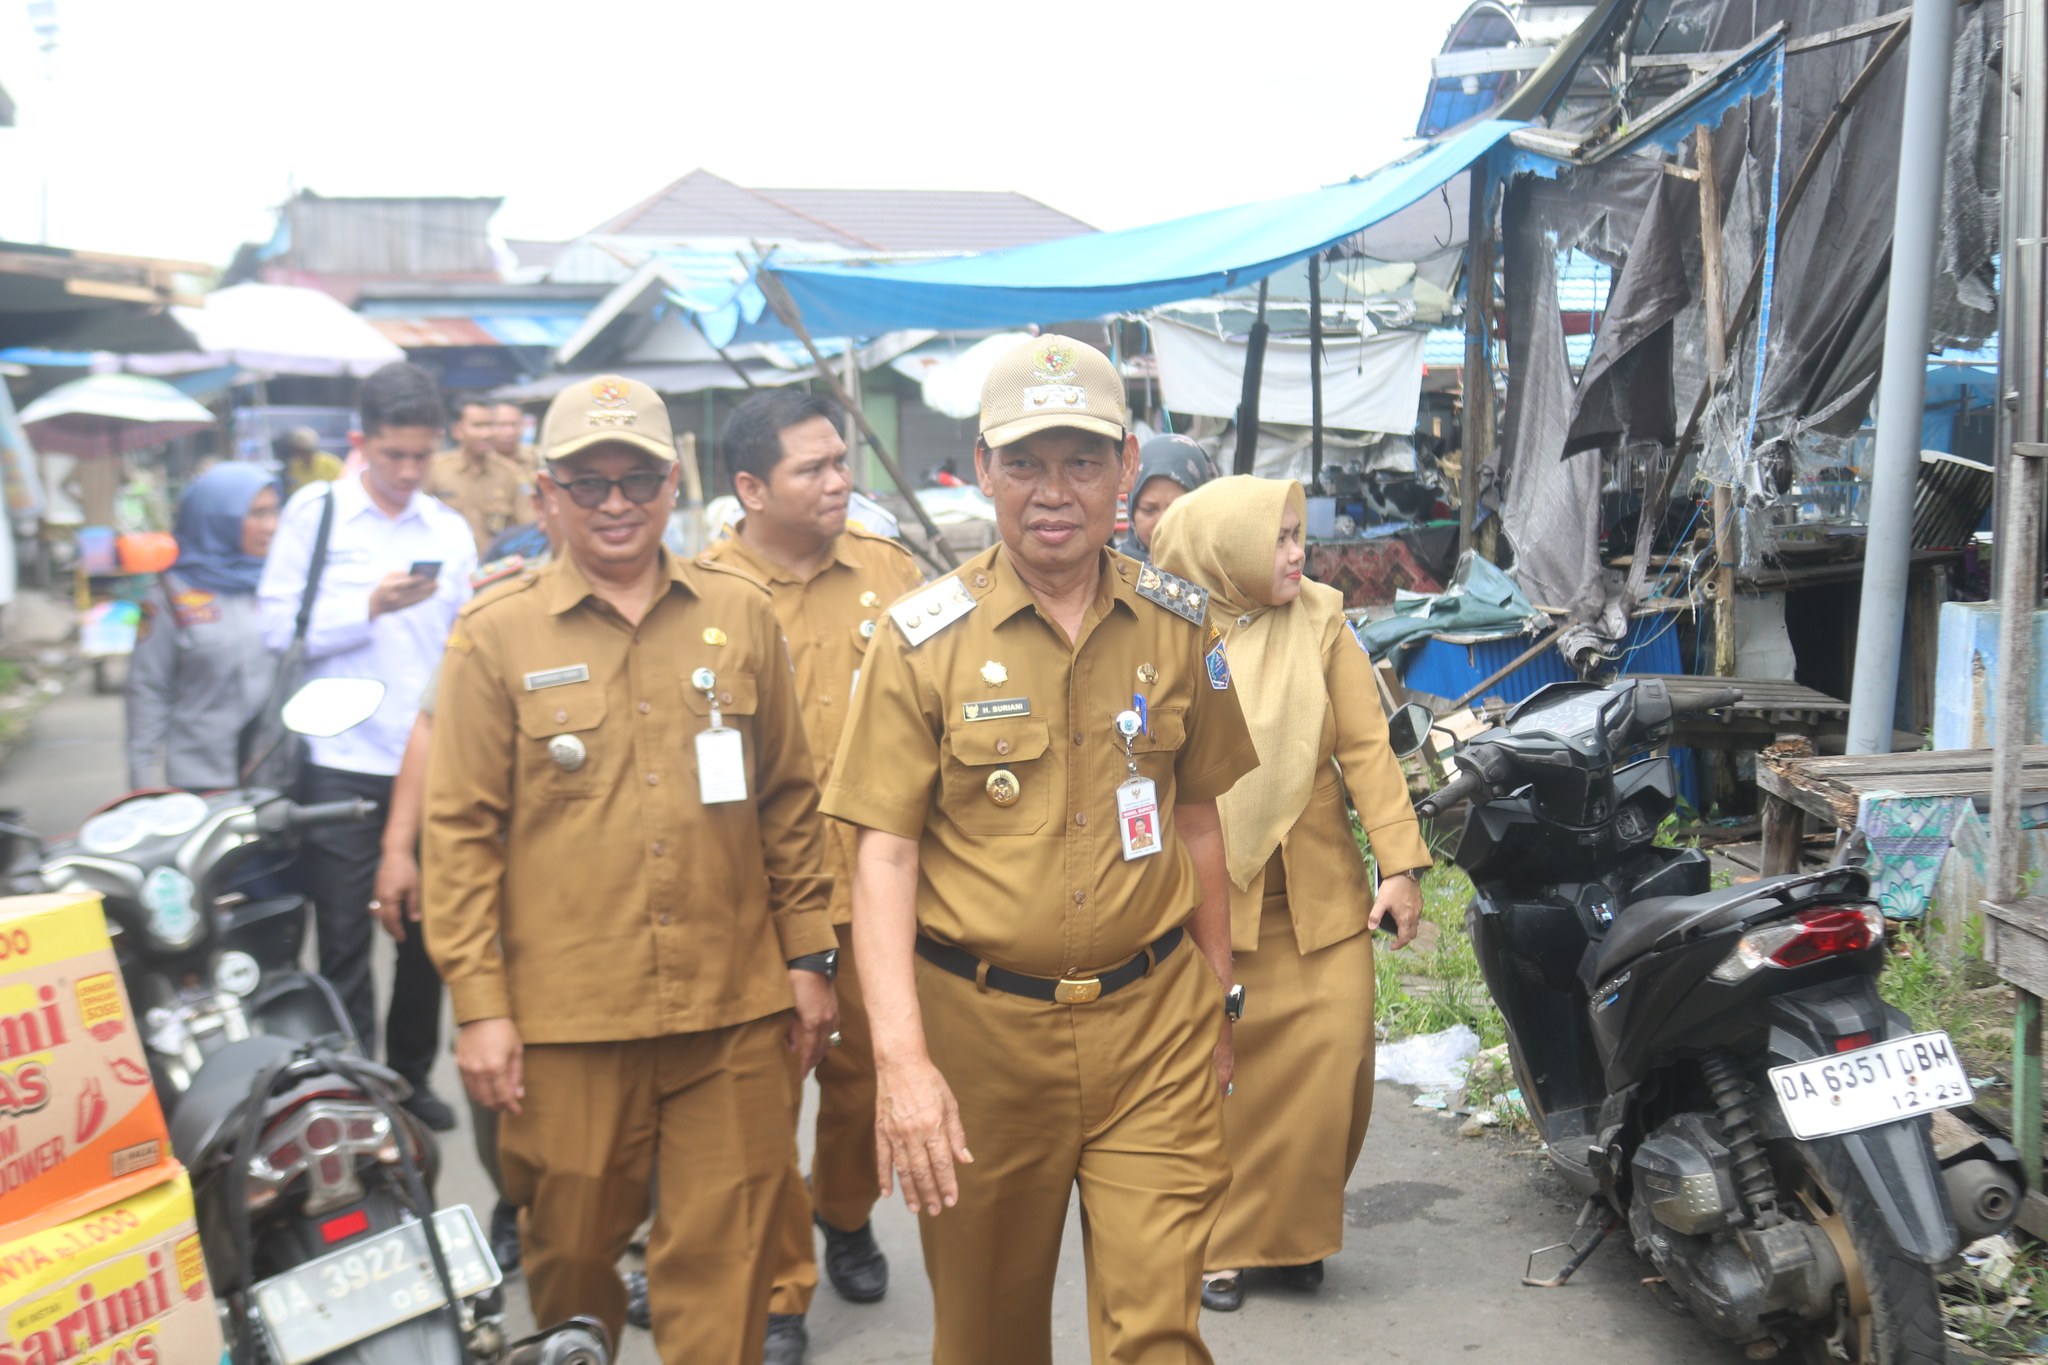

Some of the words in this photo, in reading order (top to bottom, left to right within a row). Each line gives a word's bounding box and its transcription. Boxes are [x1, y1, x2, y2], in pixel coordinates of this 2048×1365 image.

[982, 706, 991, 714] H.
[992, 703, 1024, 713] SURIANI
[1781, 1071, 1818, 1102] DA
[1822, 1053, 1892, 1092] 6351
[1898, 1039, 1954, 1076] DBM
[0, 1135, 65, 1195] OWER
[323, 1238, 413, 1299] 3922
